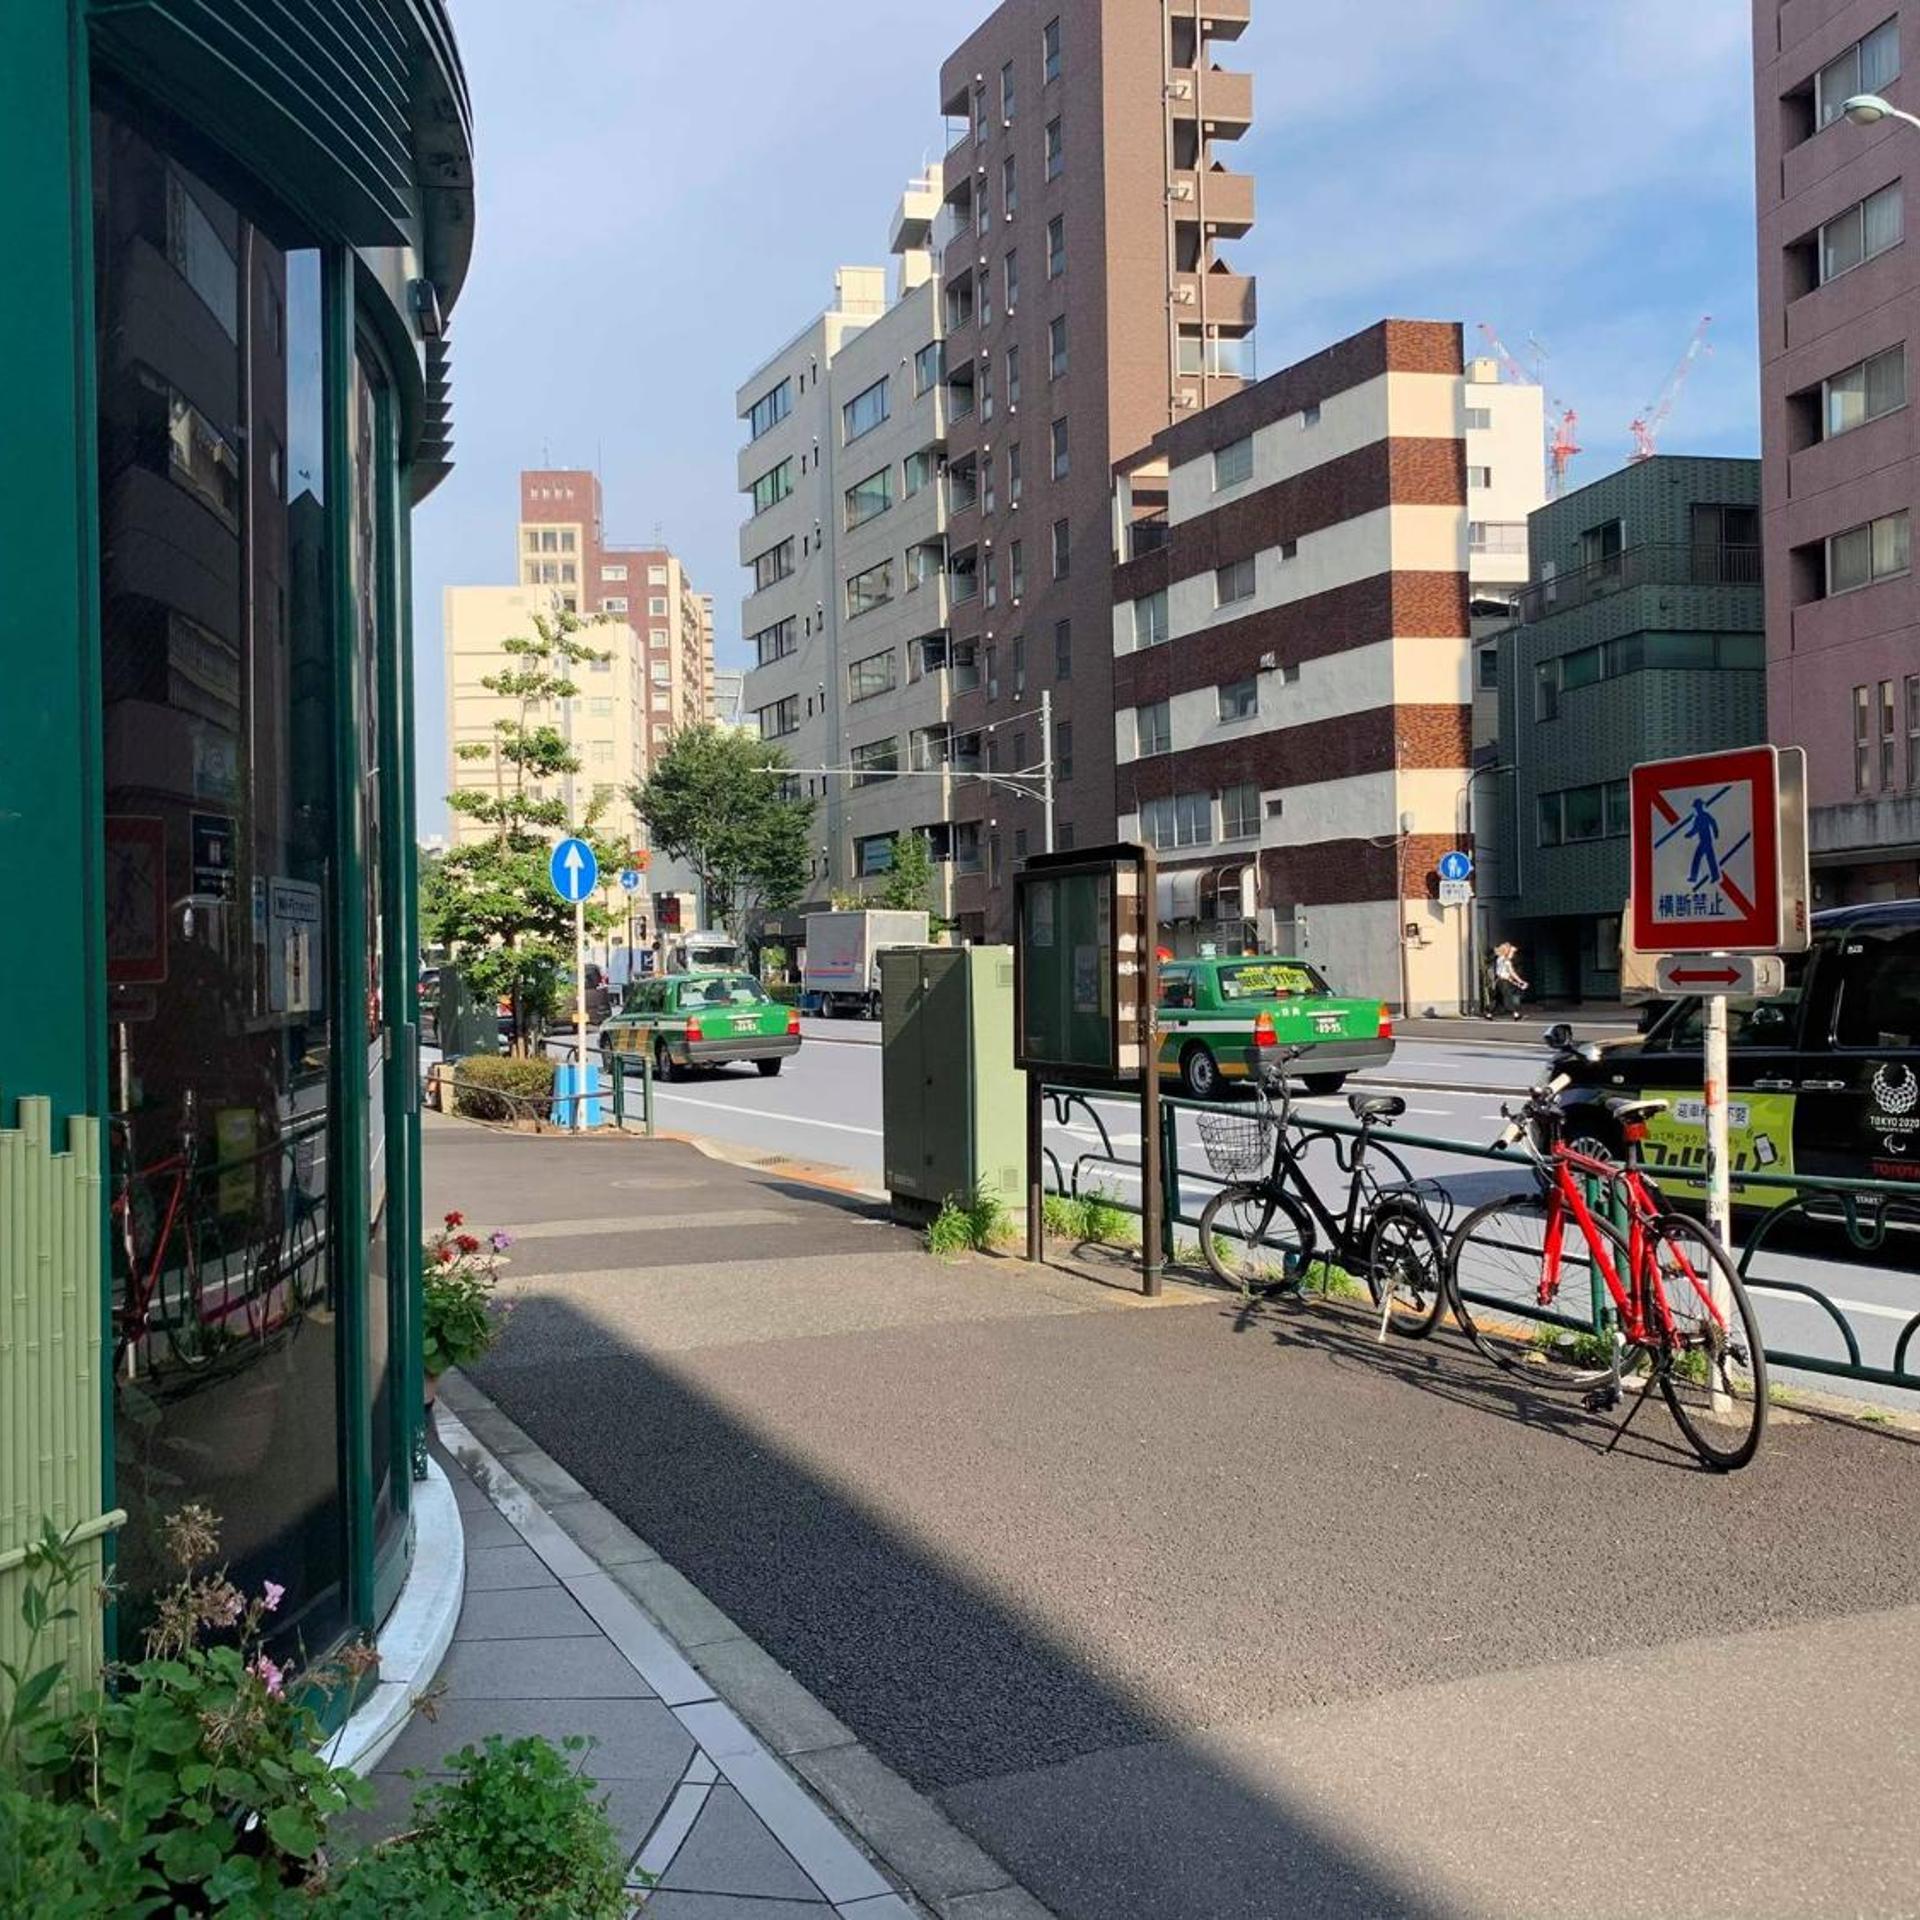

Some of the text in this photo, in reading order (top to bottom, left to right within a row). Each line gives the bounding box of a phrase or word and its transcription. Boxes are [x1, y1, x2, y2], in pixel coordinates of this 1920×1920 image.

[1659, 891, 1726, 917] 横断禁止
[1869, 1115, 1920, 1129] TOKYO 2020
